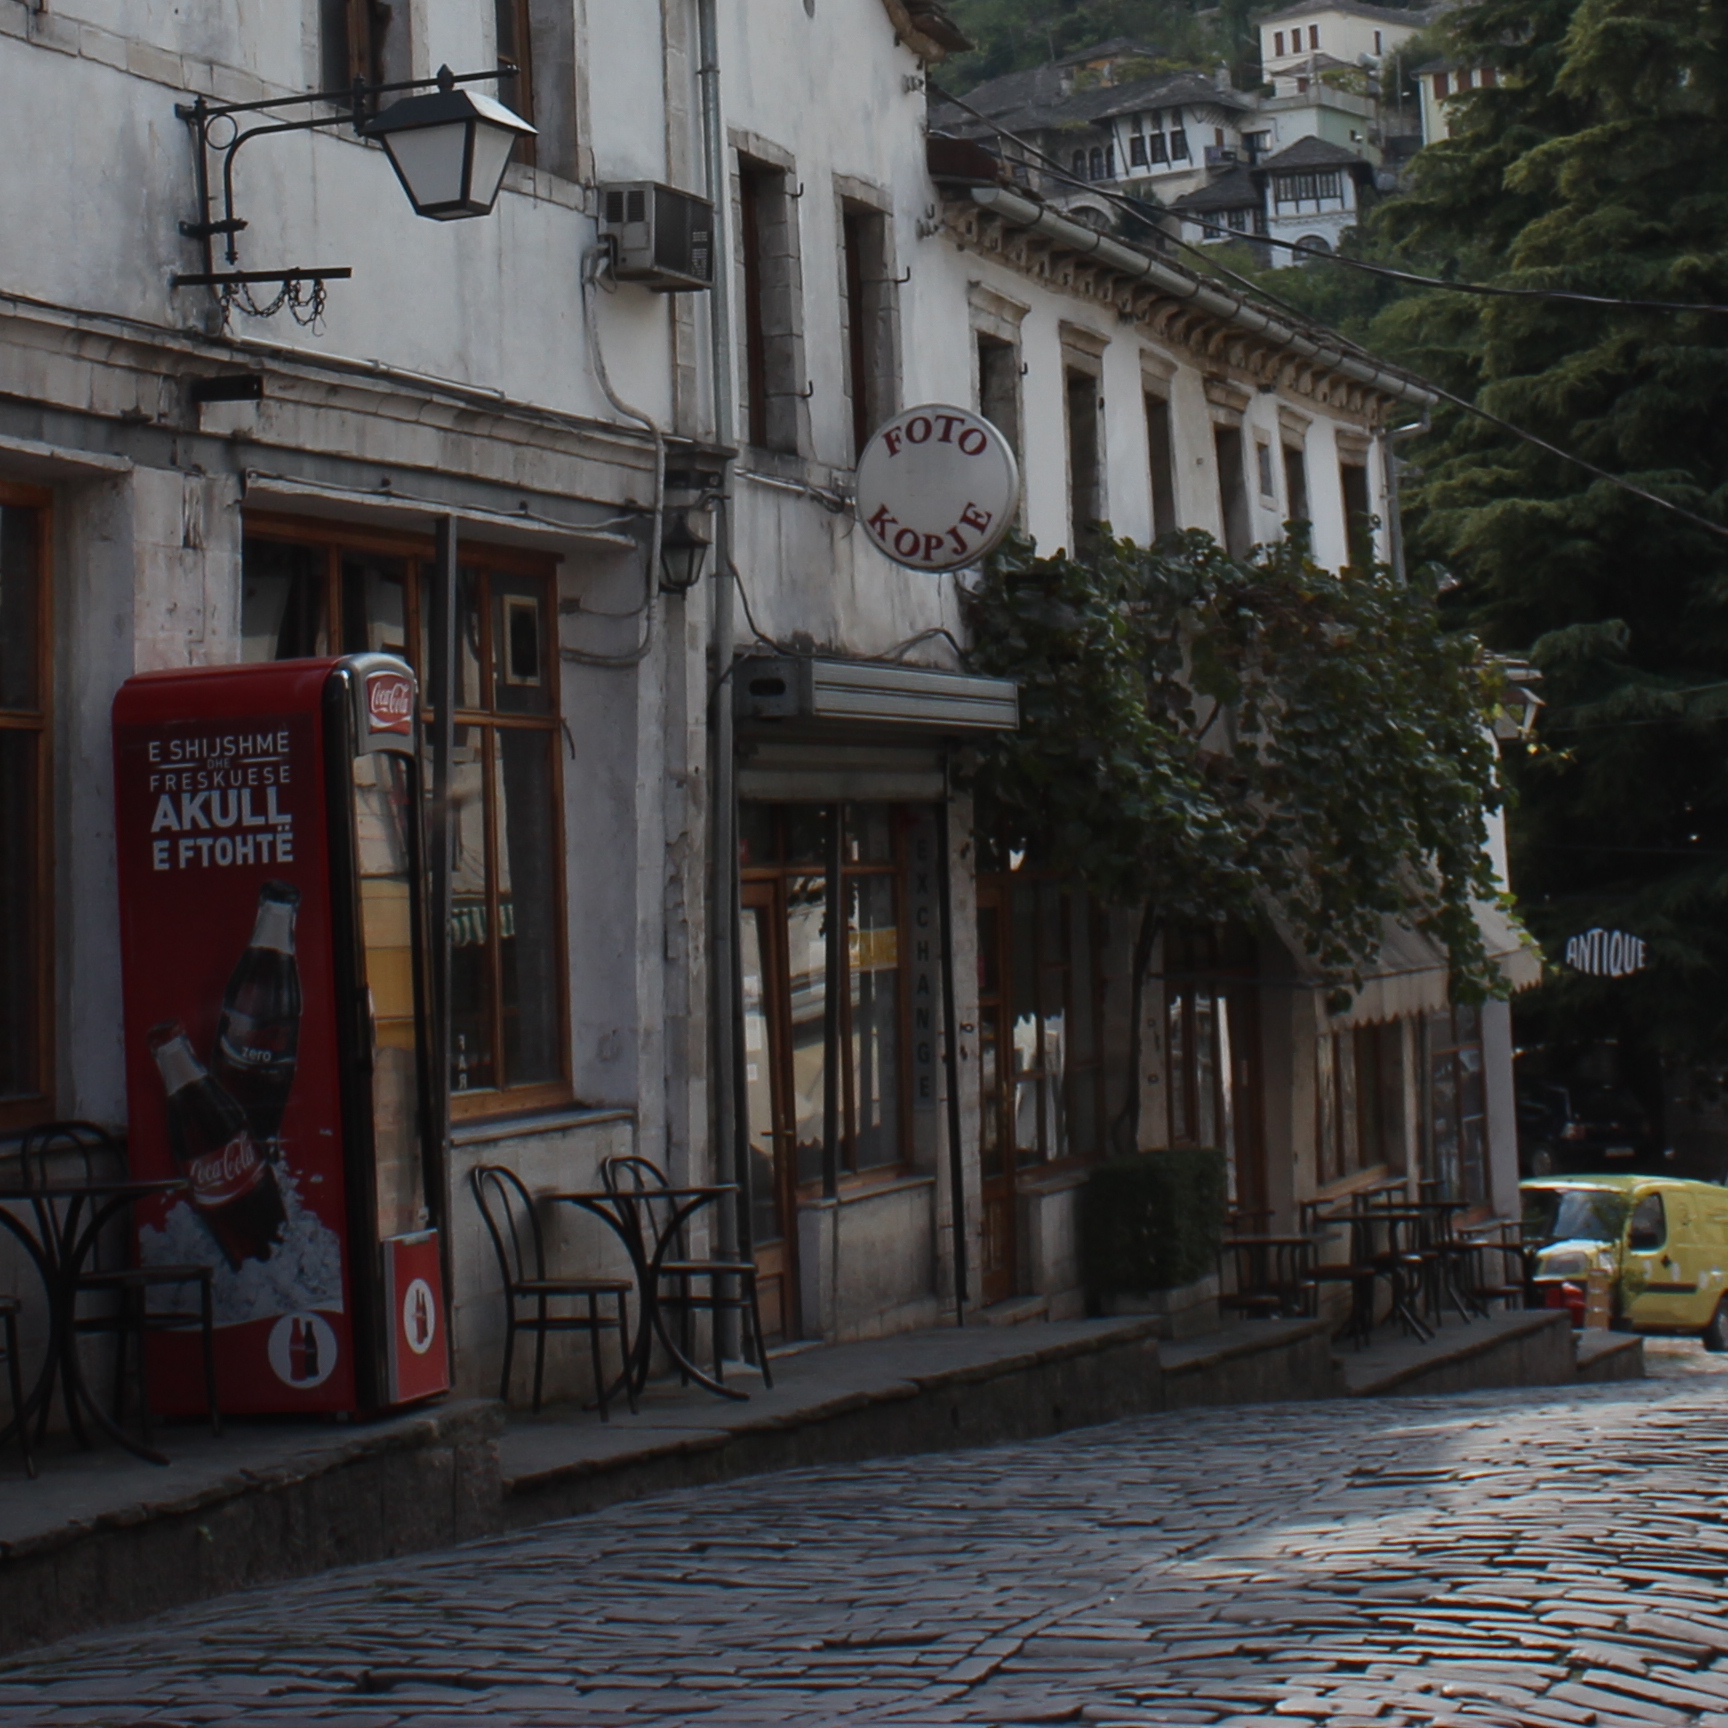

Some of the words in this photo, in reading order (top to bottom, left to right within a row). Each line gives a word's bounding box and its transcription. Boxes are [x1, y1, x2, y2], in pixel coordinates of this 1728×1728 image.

[882, 415, 987, 458] FOTO
[867, 502, 992, 561] KOPJE
[148, 741, 161, 762] E
[170, 731, 290, 760] SHIJSHME
[207, 758, 231, 770] DHE
[149, 765, 291, 792] FRESKUESE
[150, 785, 292, 833] AKULL
[153, 839, 170, 871] E
[179, 825, 294, 869] FTOHTË
[916, 839, 930, 1098] EXCHANGE
[1566, 927, 1648, 979] ANTIQUE
[241, 1046, 272, 1062] zero
